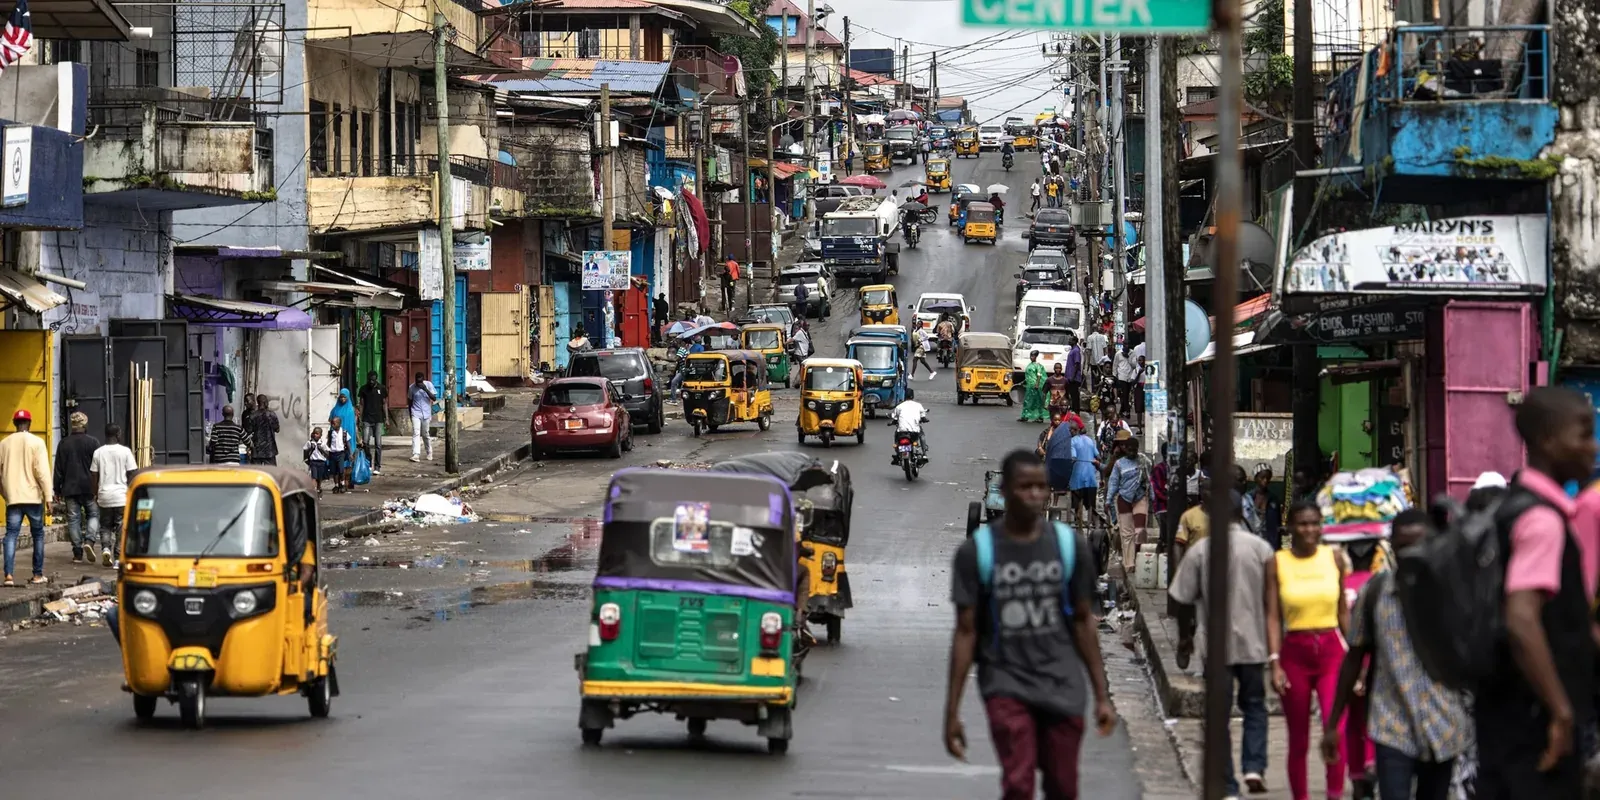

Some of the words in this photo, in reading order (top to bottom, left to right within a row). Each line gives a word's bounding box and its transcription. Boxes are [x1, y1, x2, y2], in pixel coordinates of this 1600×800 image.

[970, 0, 1154, 26] CENTER
[1394, 219, 1493, 234] MARYN'S
[1351, 312, 1394, 327] FASHION
[1333, 328, 1360, 337] BENSON
[1238, 419, 1276, 429] LAND
[1244, 429, 1287, 439] LEASE
[679, 597, 705, 607] TVS
